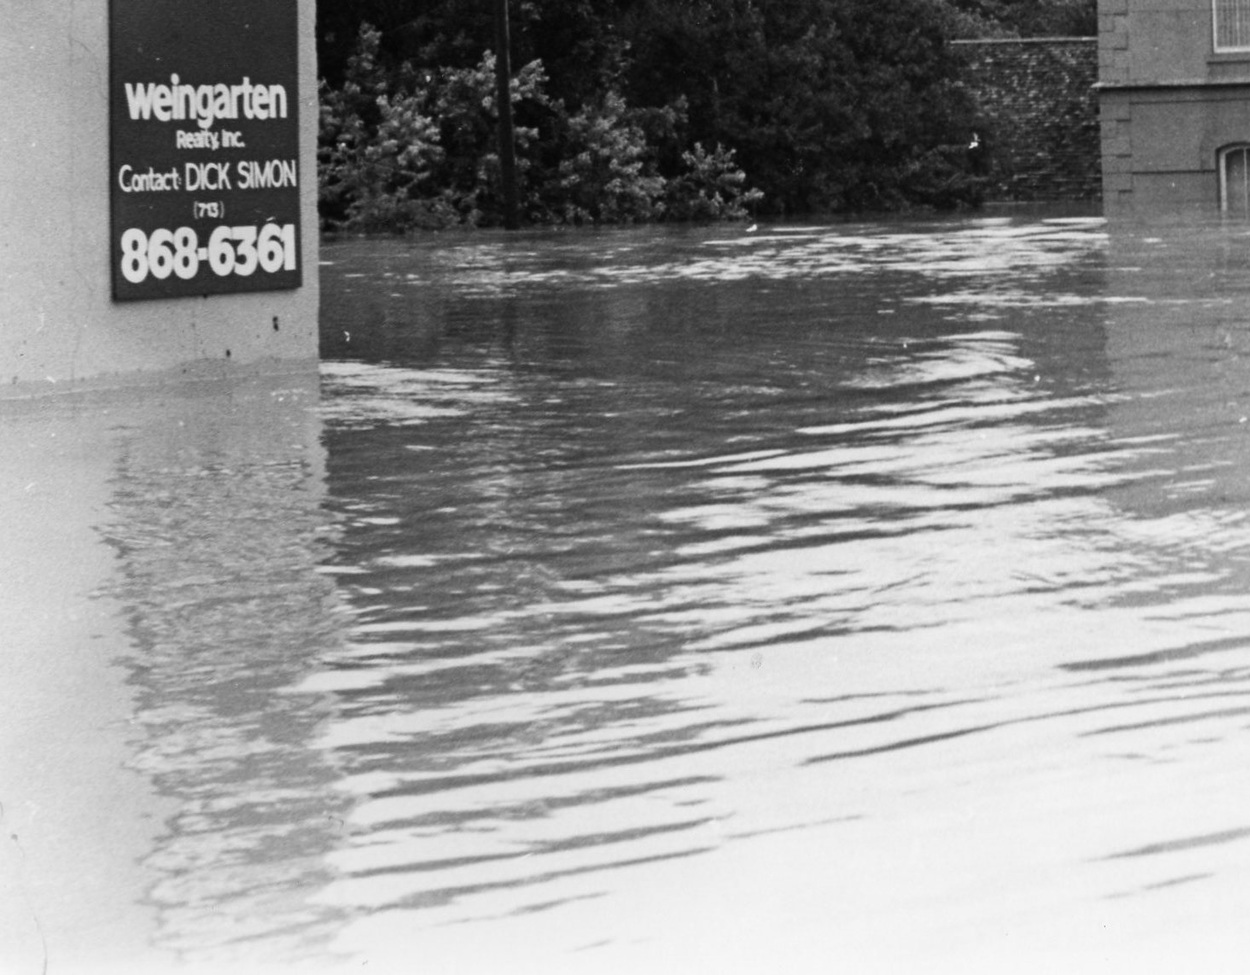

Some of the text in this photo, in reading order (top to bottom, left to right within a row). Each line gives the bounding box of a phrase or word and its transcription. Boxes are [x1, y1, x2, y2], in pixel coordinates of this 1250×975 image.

[185, 162, 232, 191] DICK
[237, 159, 297, 189] SIMON
[193, 200, 225, 219] (713)
[121, 223, 296, 284] 868-6361
